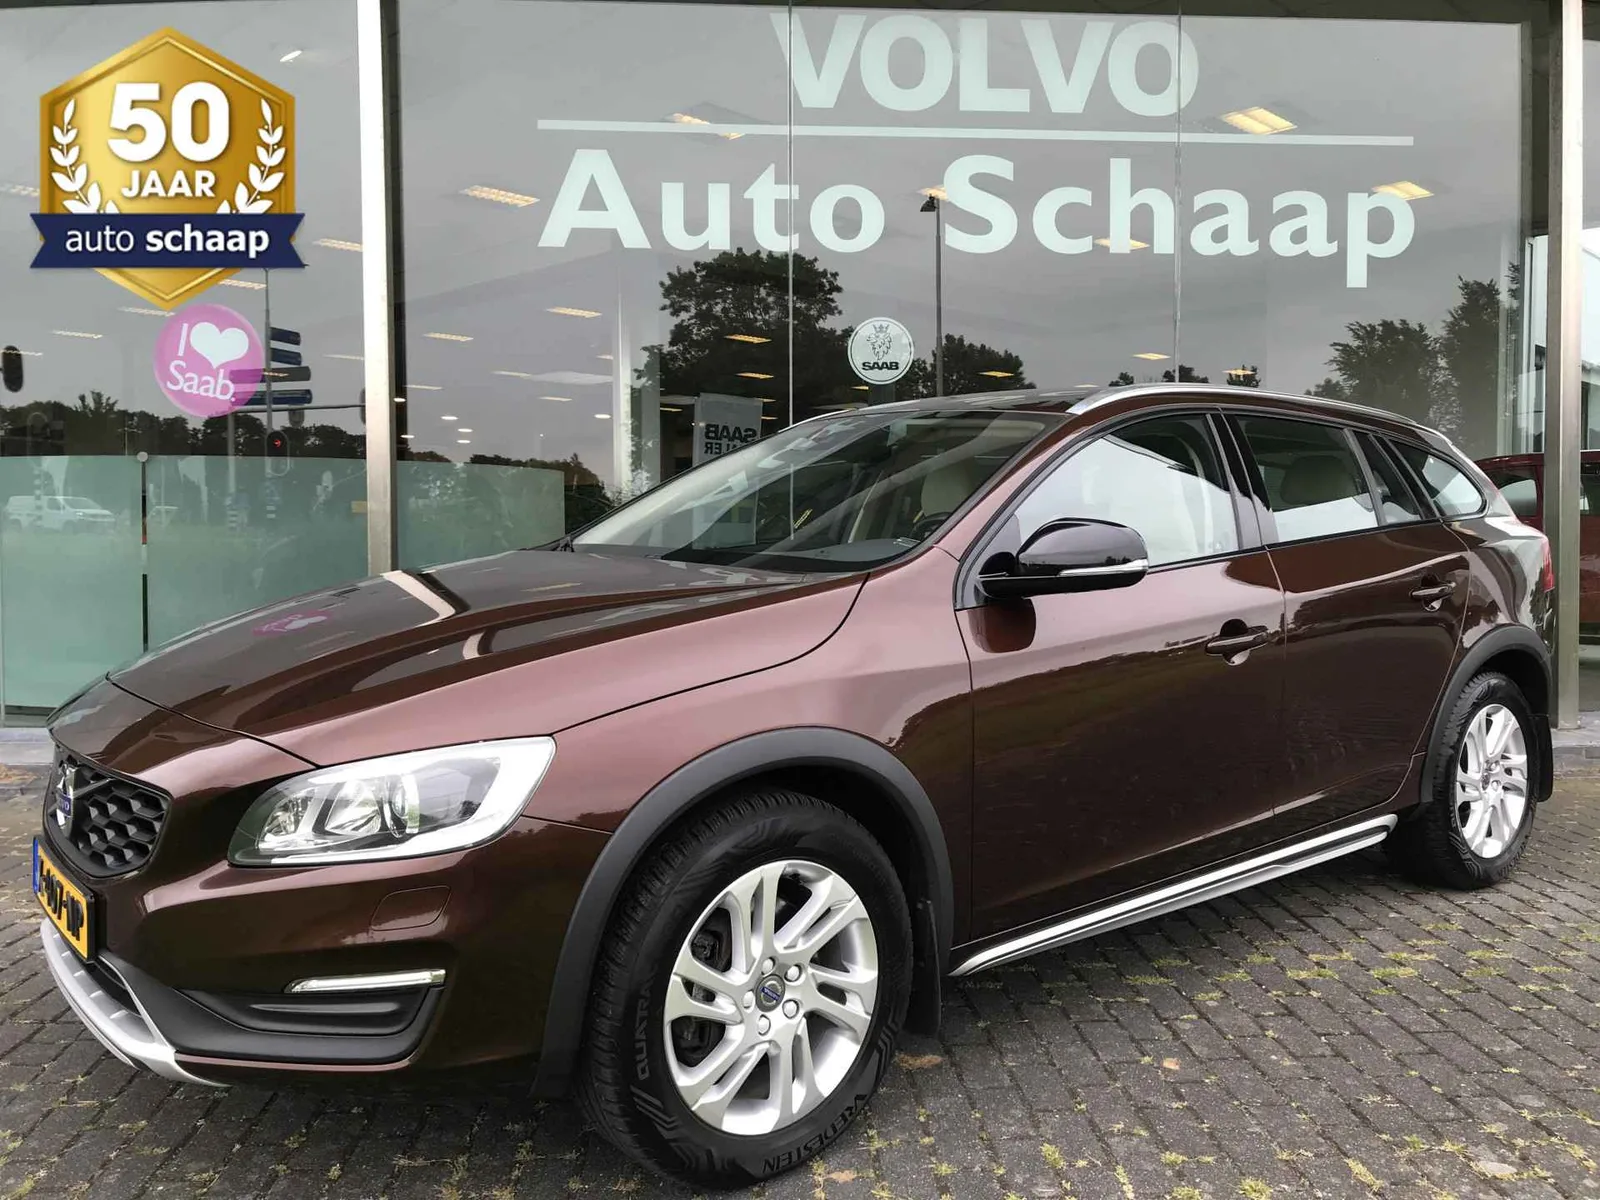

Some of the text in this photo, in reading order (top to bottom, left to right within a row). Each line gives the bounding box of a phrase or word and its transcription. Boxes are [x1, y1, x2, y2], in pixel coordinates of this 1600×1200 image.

[769, 13, 1199, 117] VOLVO
[537, 149, 1416, 288] Auto Schaap
[177, 322, 189, 357] I
[861, 360, 900, 372] SAAB
